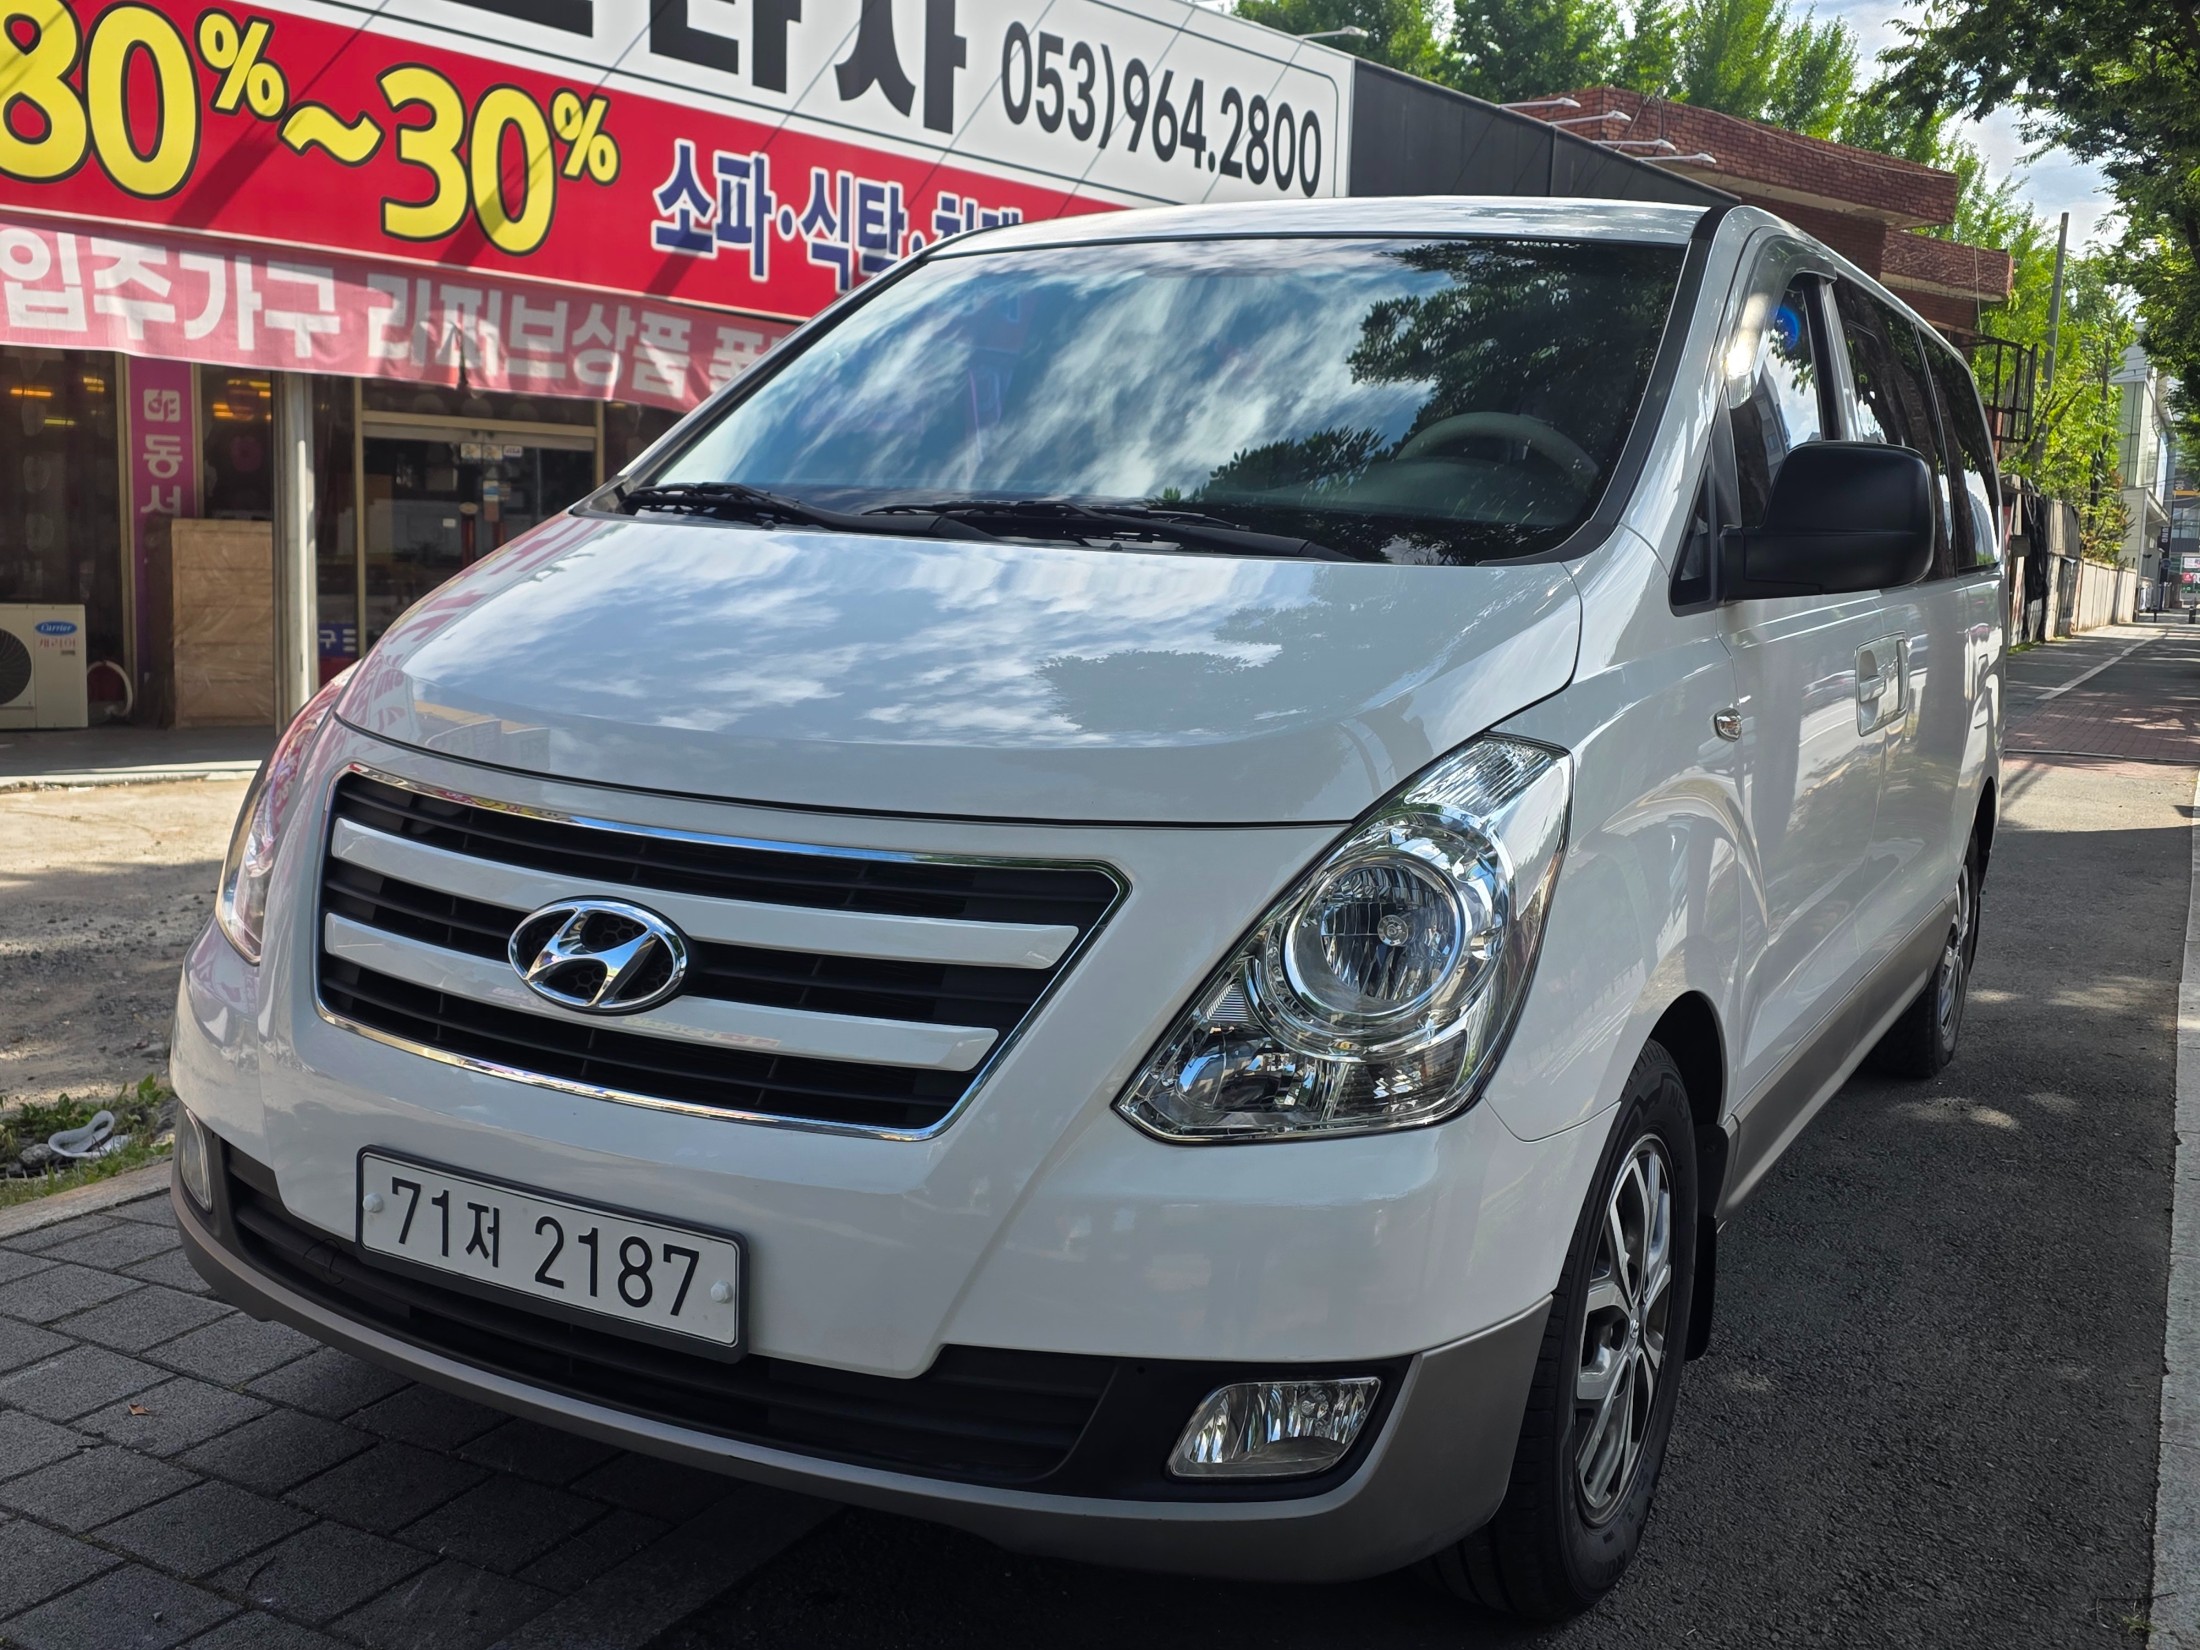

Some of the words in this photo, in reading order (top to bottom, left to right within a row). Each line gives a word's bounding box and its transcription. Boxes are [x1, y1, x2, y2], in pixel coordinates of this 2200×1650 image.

[1002, 21, 1321, 197] 053)964.2800
[0, 228, 341, 358] 입주가구
[367, 273, 691, 399] 리퍼브상품
[392, 1176, 500, 1268] 71저
[534, 1216, 700, 1317] 2187
